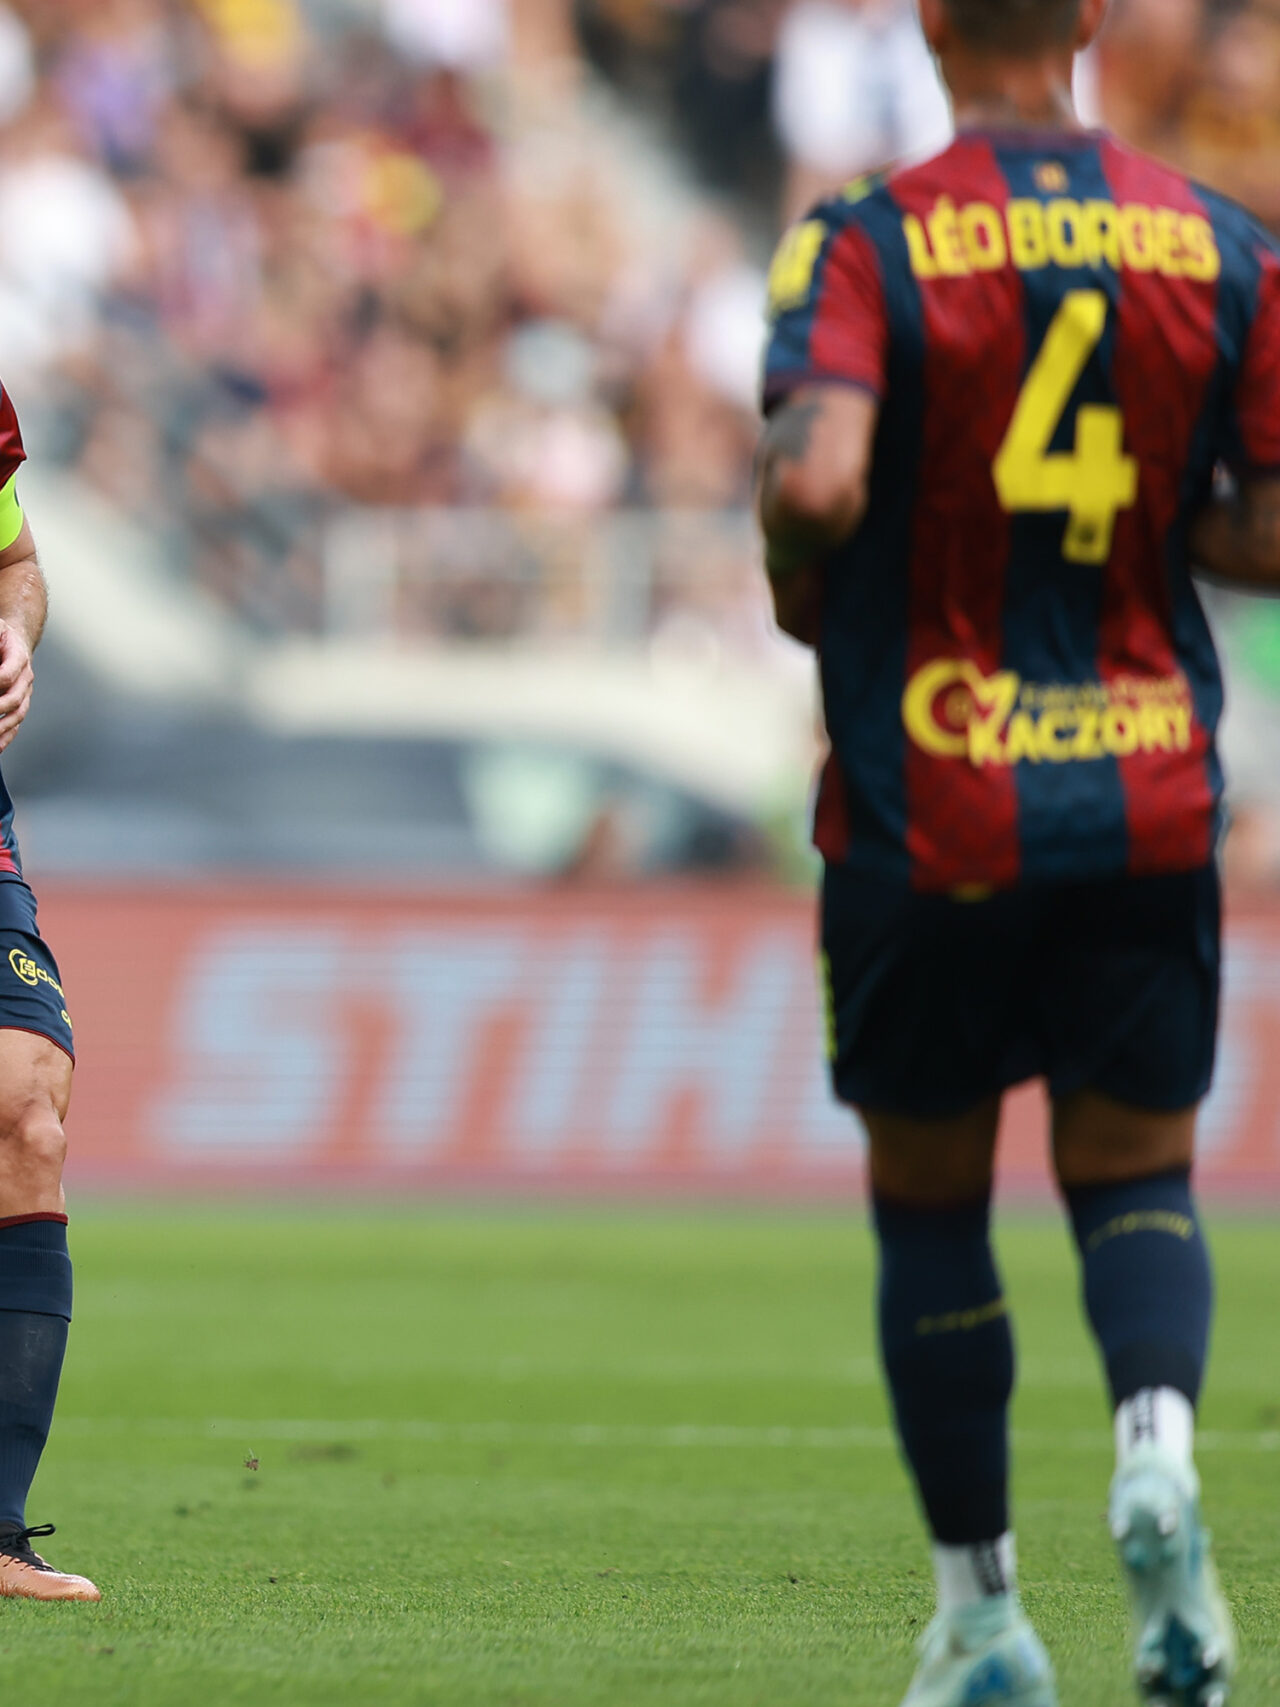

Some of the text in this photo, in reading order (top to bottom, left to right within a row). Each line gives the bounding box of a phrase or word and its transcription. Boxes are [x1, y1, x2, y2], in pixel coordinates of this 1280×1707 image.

[902, 193, 1007, 279] LÉO
[1005, 196, 1220, 283] BORGES
[992, 289, 1140, 566] 4
